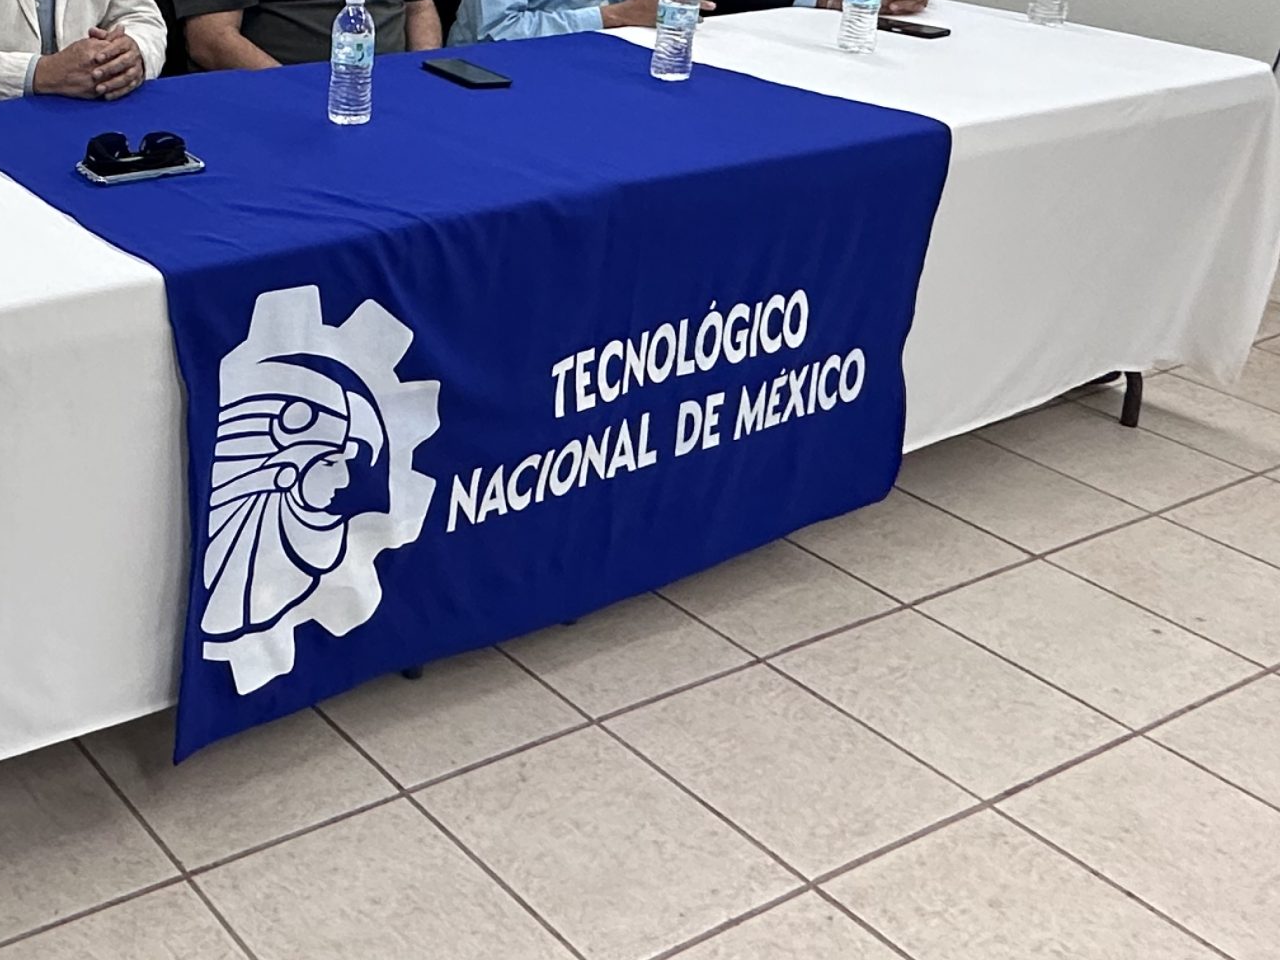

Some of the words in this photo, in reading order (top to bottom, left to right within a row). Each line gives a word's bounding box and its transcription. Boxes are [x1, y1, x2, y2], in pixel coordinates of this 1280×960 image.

[551, 289, 809, 419] TECNOLÓGICO
[446, 412, 658, 533] NACIONAL
[674, 391, 726, 458] DE
[733, 348, 867, 441] MÉXICO
